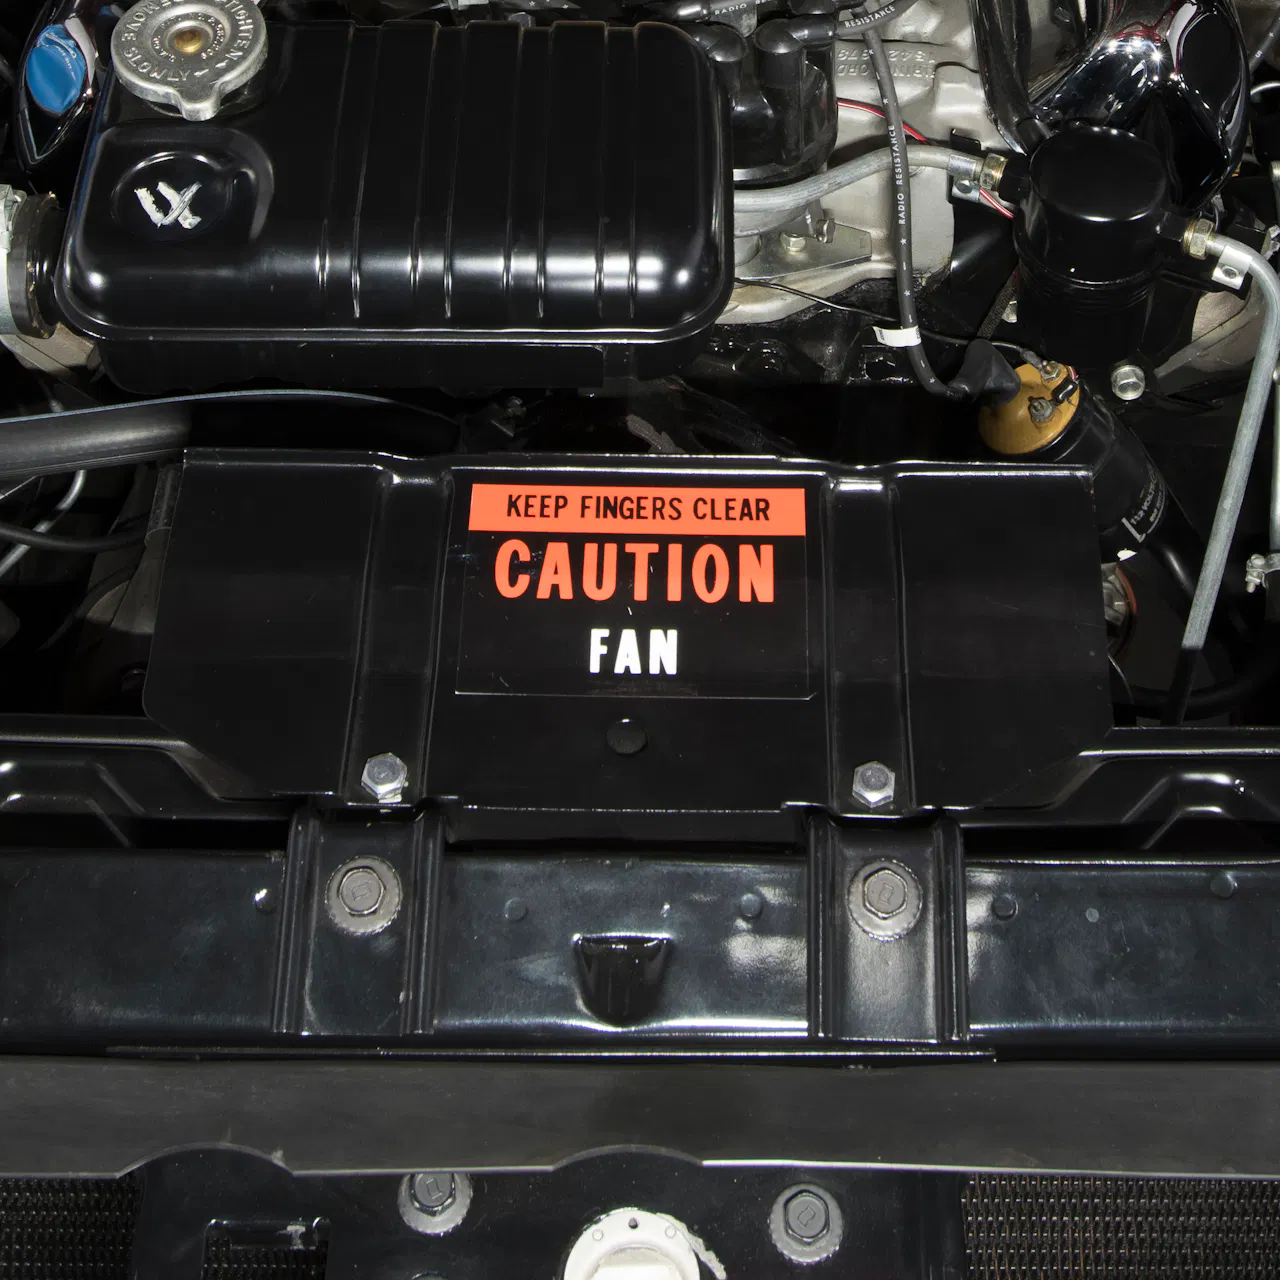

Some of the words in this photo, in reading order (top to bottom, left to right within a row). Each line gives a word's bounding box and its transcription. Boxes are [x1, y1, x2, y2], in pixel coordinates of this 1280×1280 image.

[714, 3, 747, 16] RADIO
[844, 5, 896, 28] RESISTANCE
[888, 124, 904, 185] RESISTANCE
[898, 192, 906, 225] RADIO
[507, 494, 569, 519] KEEP
[580, 495, 683, 521] FINGERS
[693, 497, 771, 522] CLEAR
[494, 538, 776, 604] CAUTION
[589, 628, 679, 676] FAN
